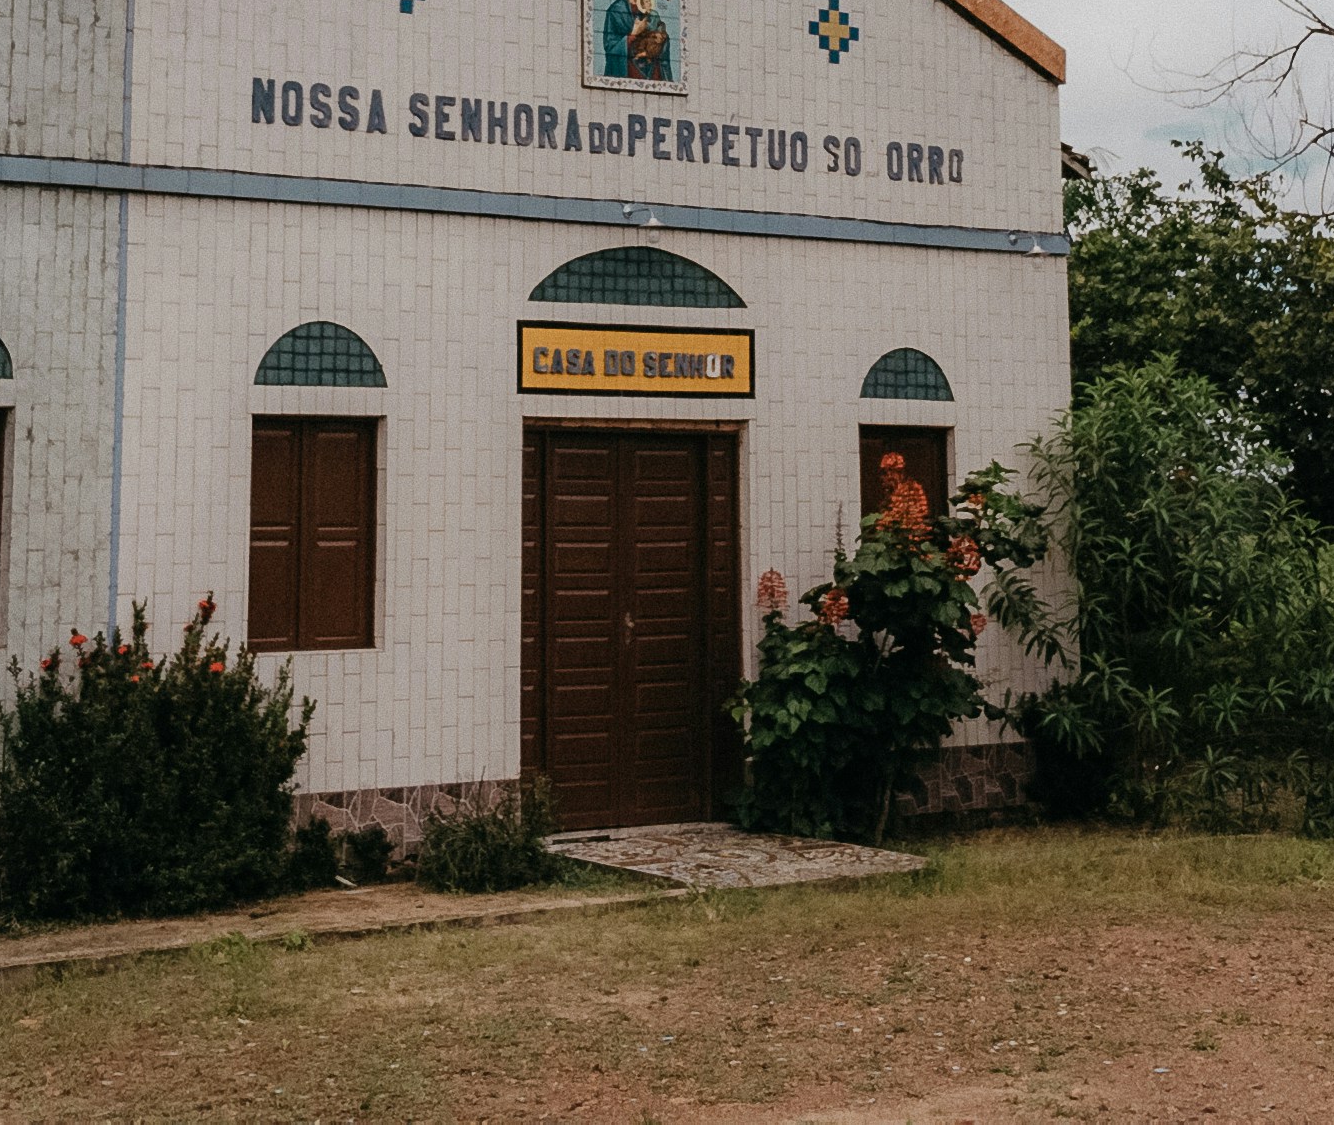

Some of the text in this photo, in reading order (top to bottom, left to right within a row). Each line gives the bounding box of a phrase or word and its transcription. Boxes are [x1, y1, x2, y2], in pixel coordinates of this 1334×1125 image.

[252, 77, 387, 134] NOSSA
[408, 92, 582, 151] SENHORA
[588, 121, 623, 154] DO
[533, 347, 734, 379] CASA DO SENHOR
